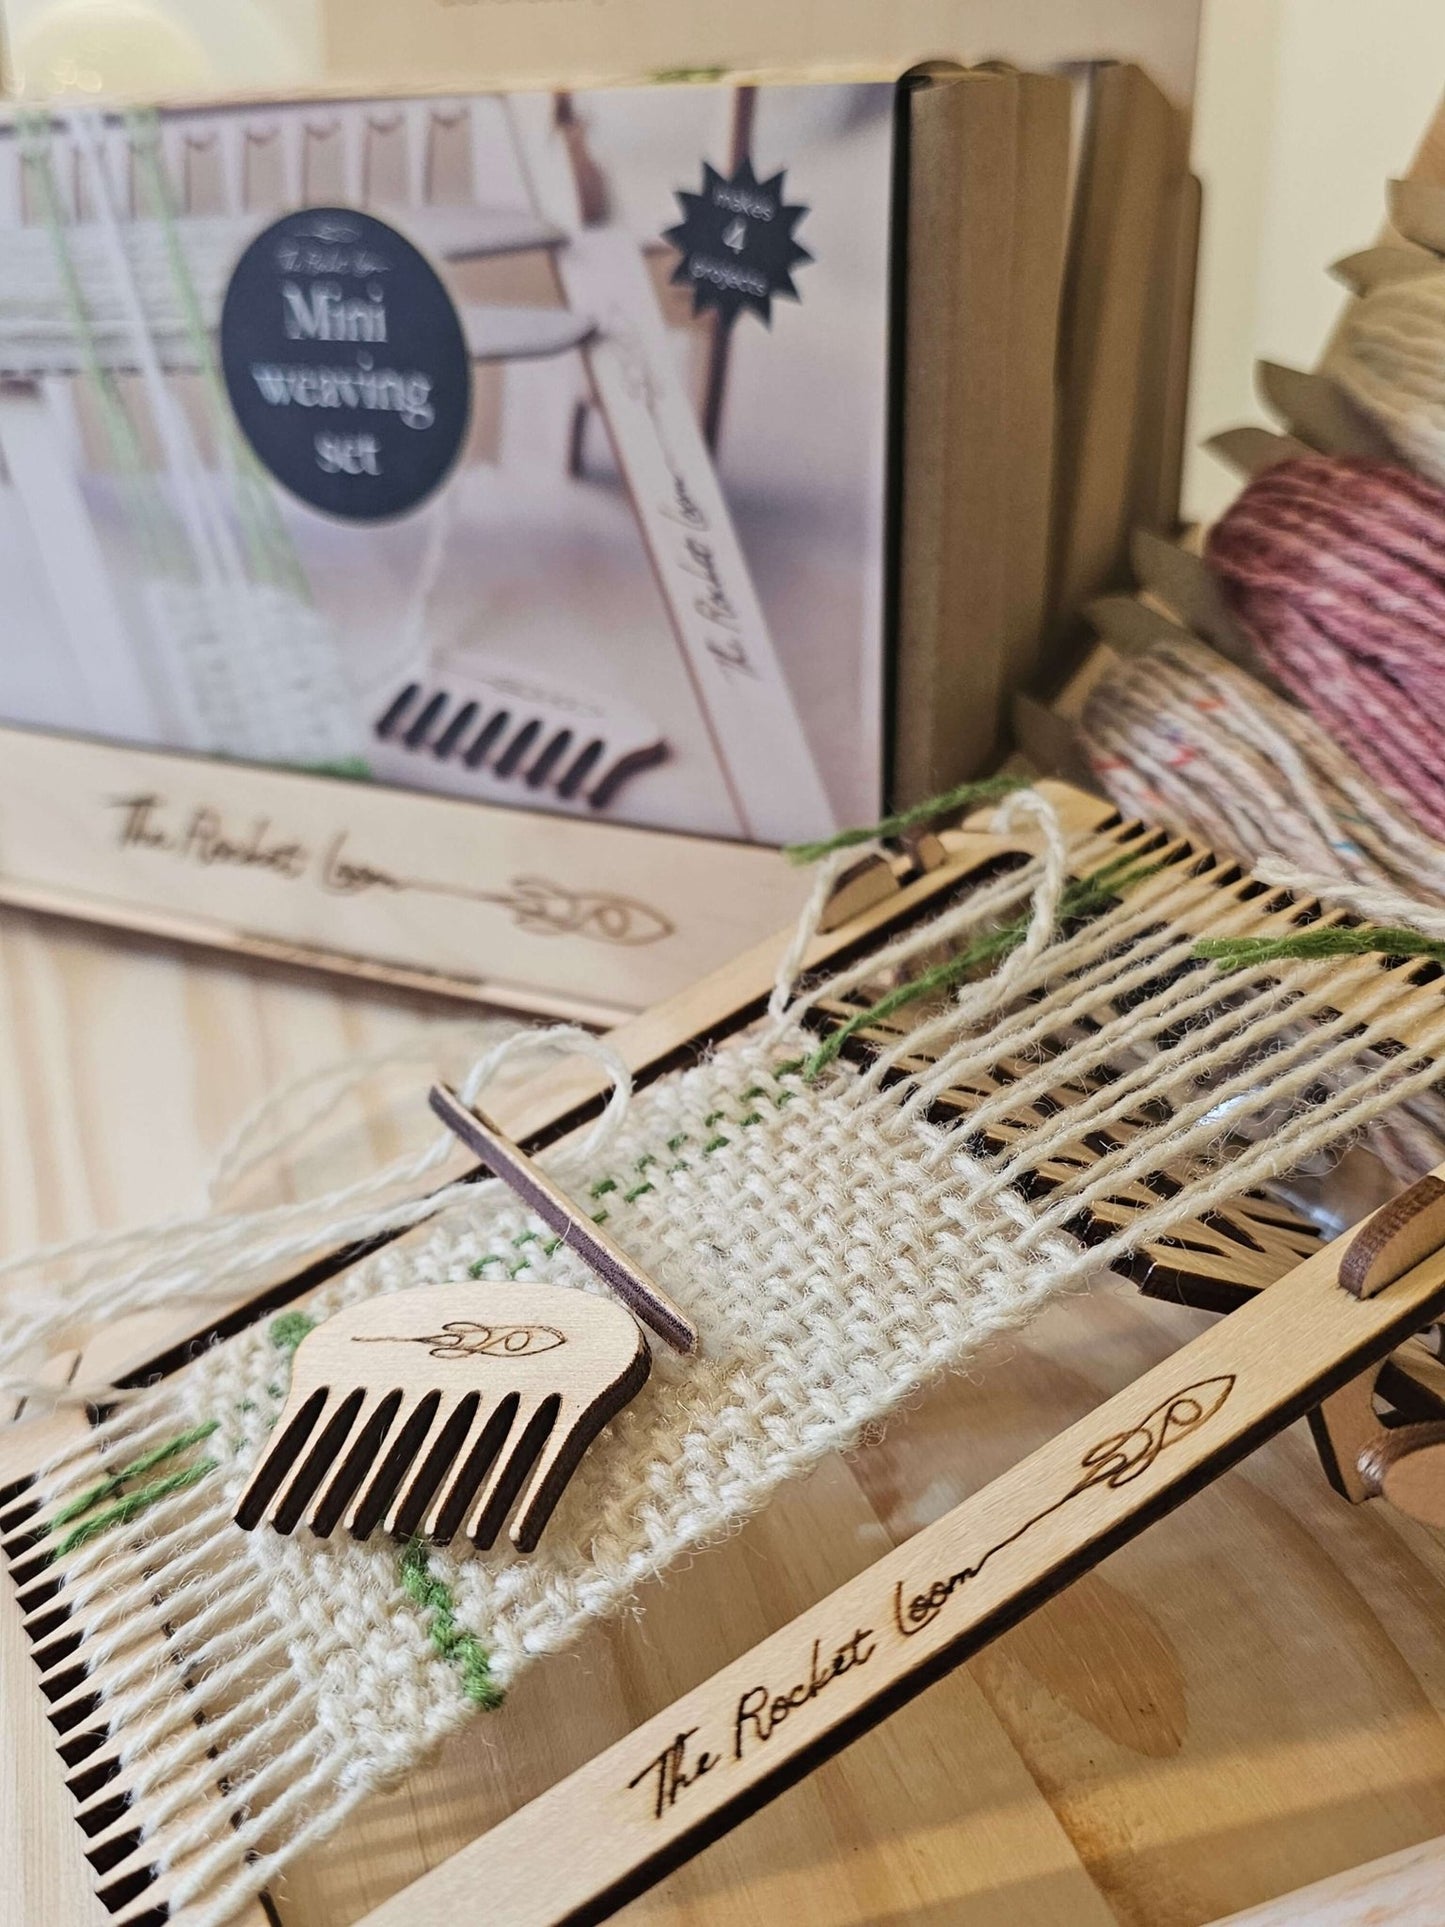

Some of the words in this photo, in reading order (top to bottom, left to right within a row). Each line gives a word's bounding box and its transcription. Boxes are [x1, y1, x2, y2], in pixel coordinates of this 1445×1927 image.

[722, 216, 747, 255] 4
[282, 280, 388, 343] Mini
[251, 351, 436, 431] weaving
[313, 433, 384, 476] set
[627, 1726, 721, 1820] The
[735, 1628, 877, 1761] Rocket
[894, 1565, 980, 1637] Loom
